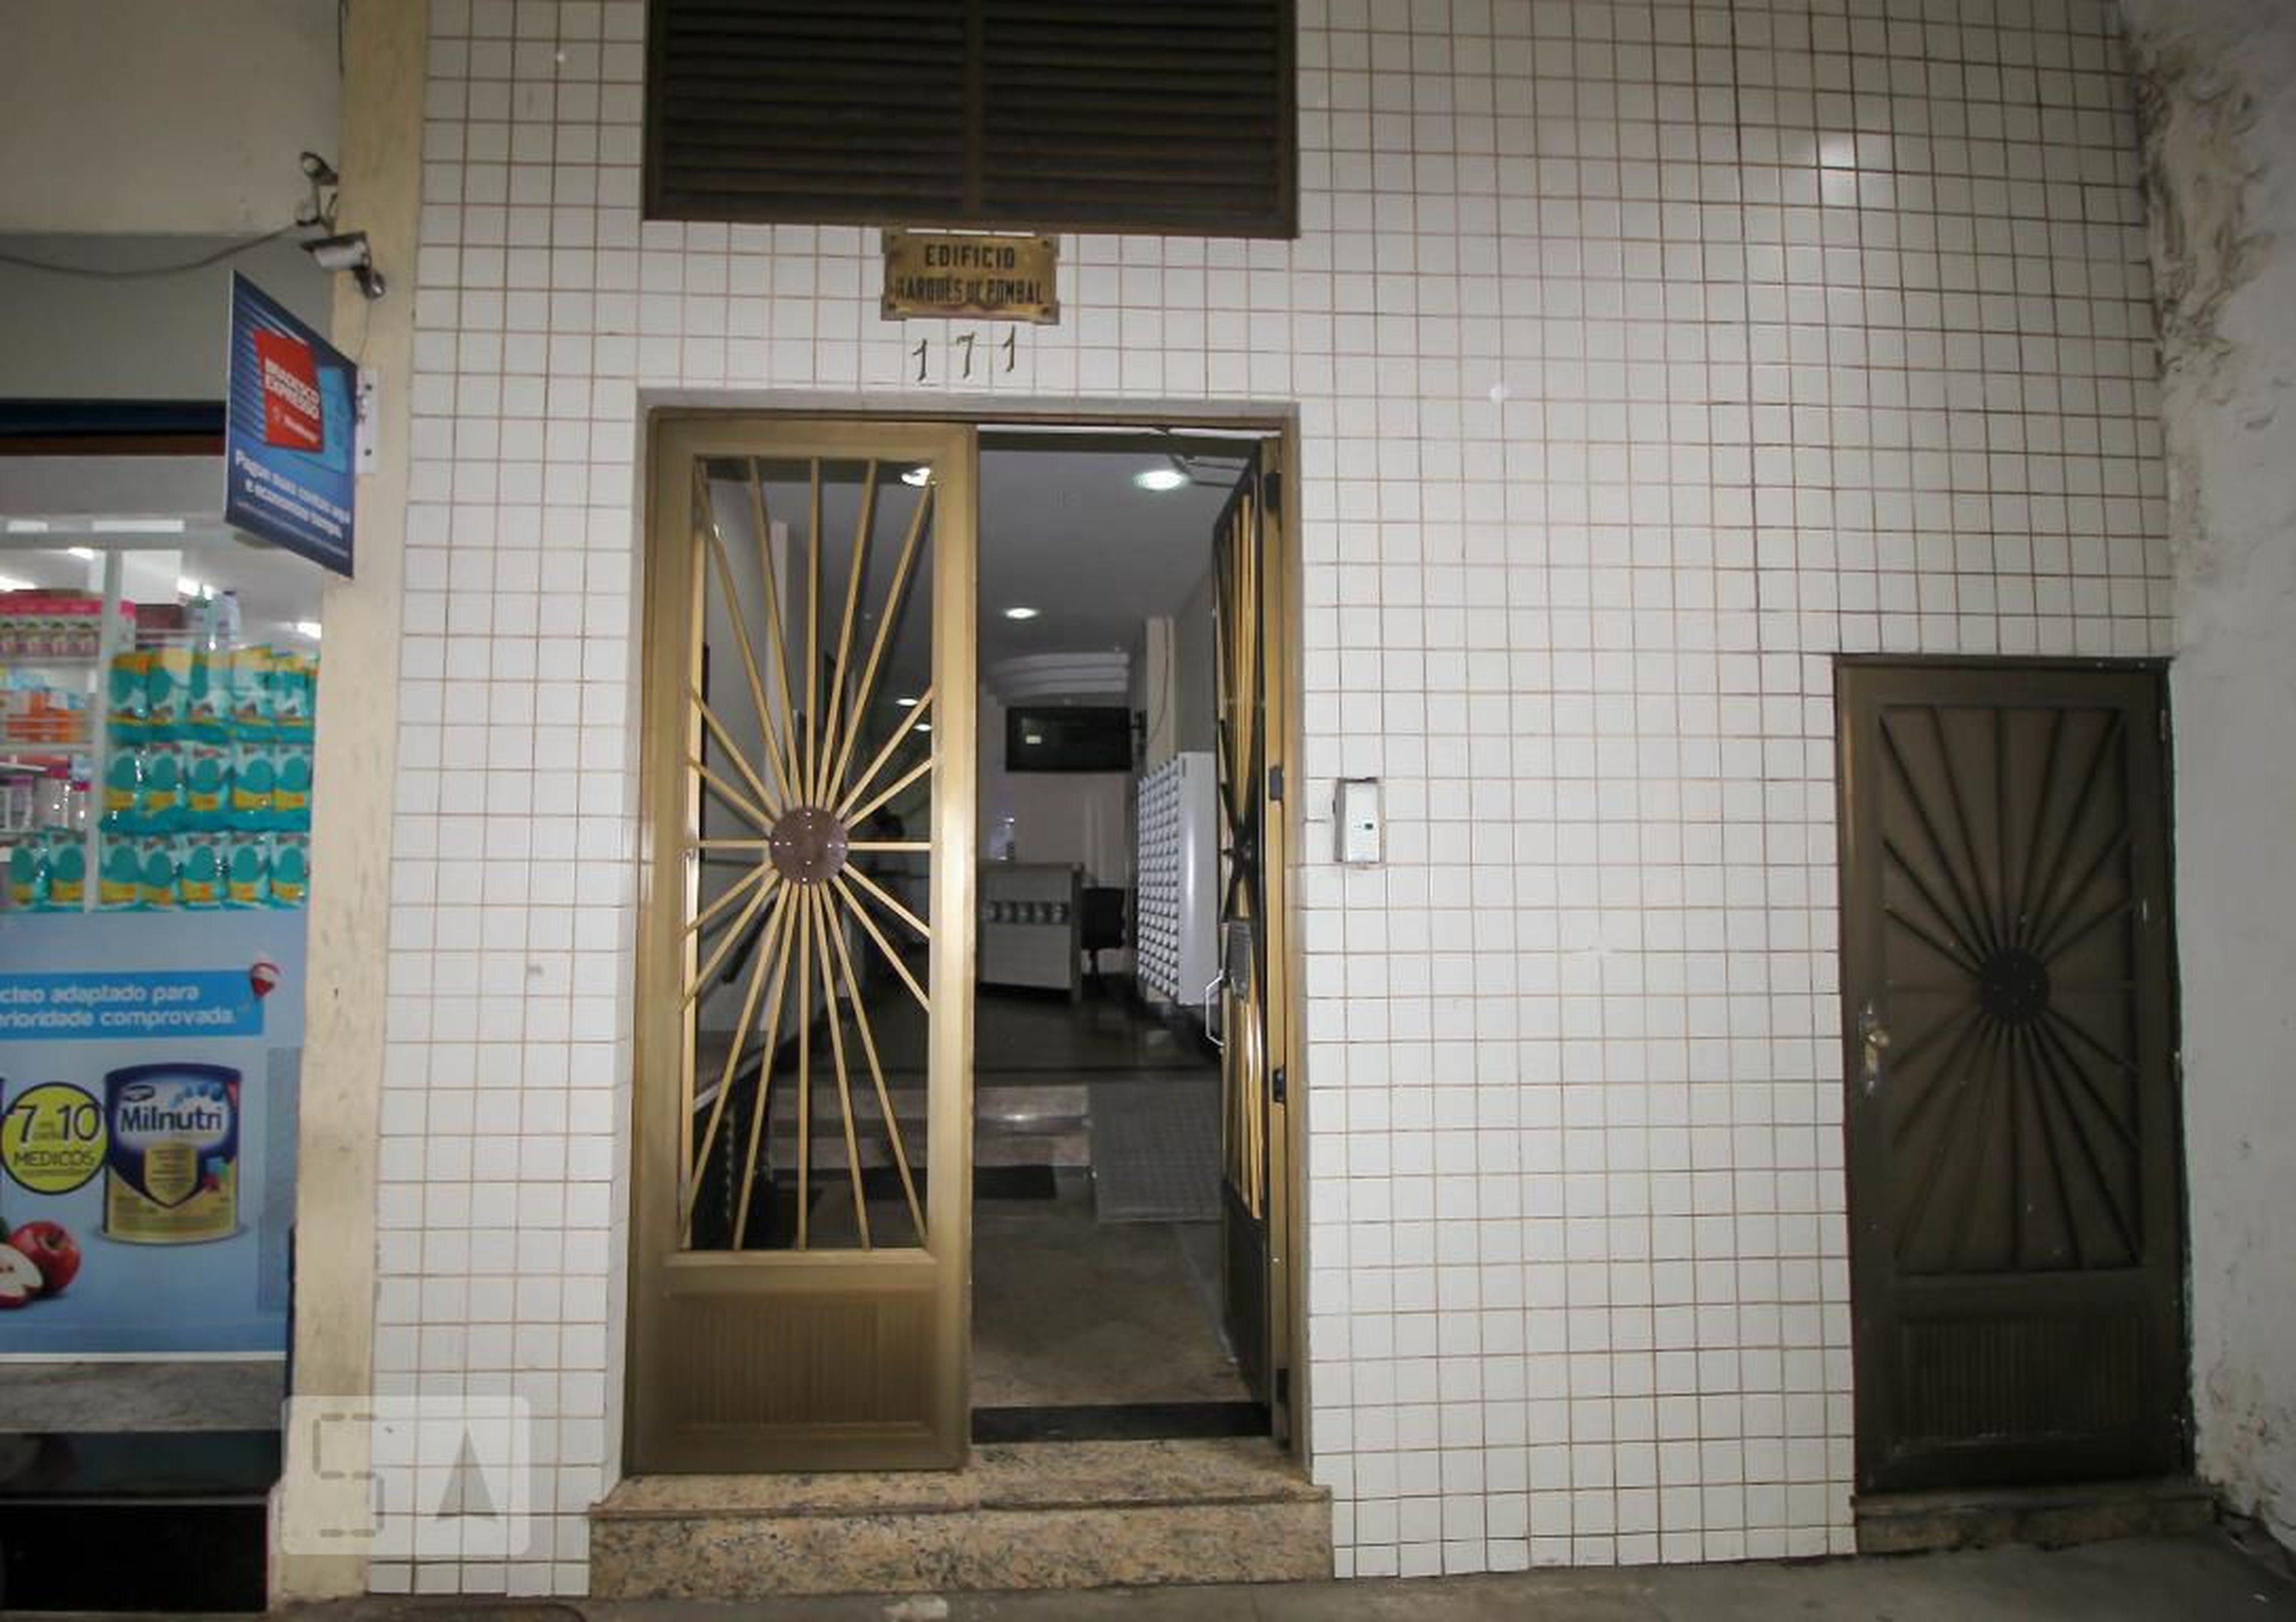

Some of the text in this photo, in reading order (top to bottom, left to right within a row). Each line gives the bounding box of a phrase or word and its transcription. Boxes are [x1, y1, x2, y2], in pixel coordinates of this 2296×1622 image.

[926, 244, 1015, 268] EDIFICIO
[51, 985, 146, 1007] adaptado
[152, 985, 199, 1005] para
[57, 1102, 102, 1141] 10
[120, 1106, 222, 1132] Milnutri
